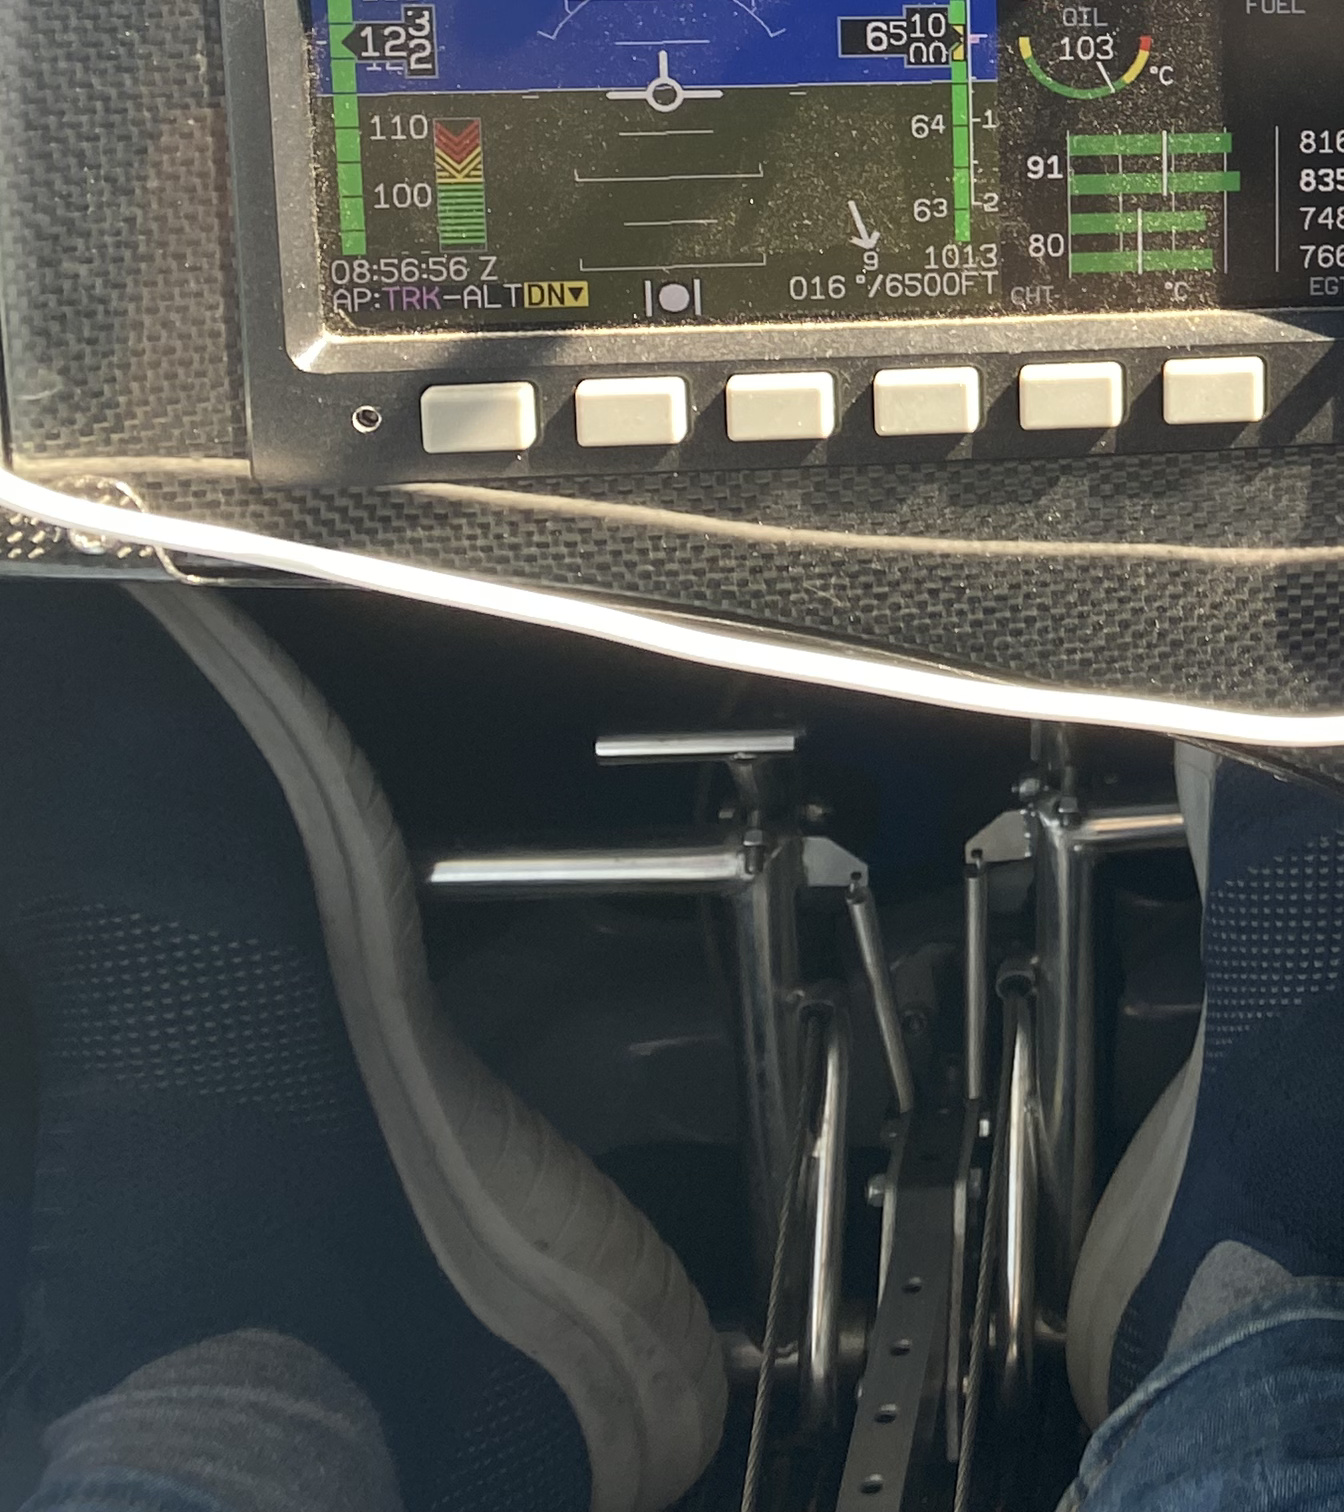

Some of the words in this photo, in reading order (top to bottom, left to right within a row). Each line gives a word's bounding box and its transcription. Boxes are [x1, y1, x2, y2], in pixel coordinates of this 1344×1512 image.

[1063, 7, 1107, 26] OIL
[1027, 157, 1063, 179] 91
[374, 185, 431, 208] 100
[332, 258, 468, 285] 08:56:56
